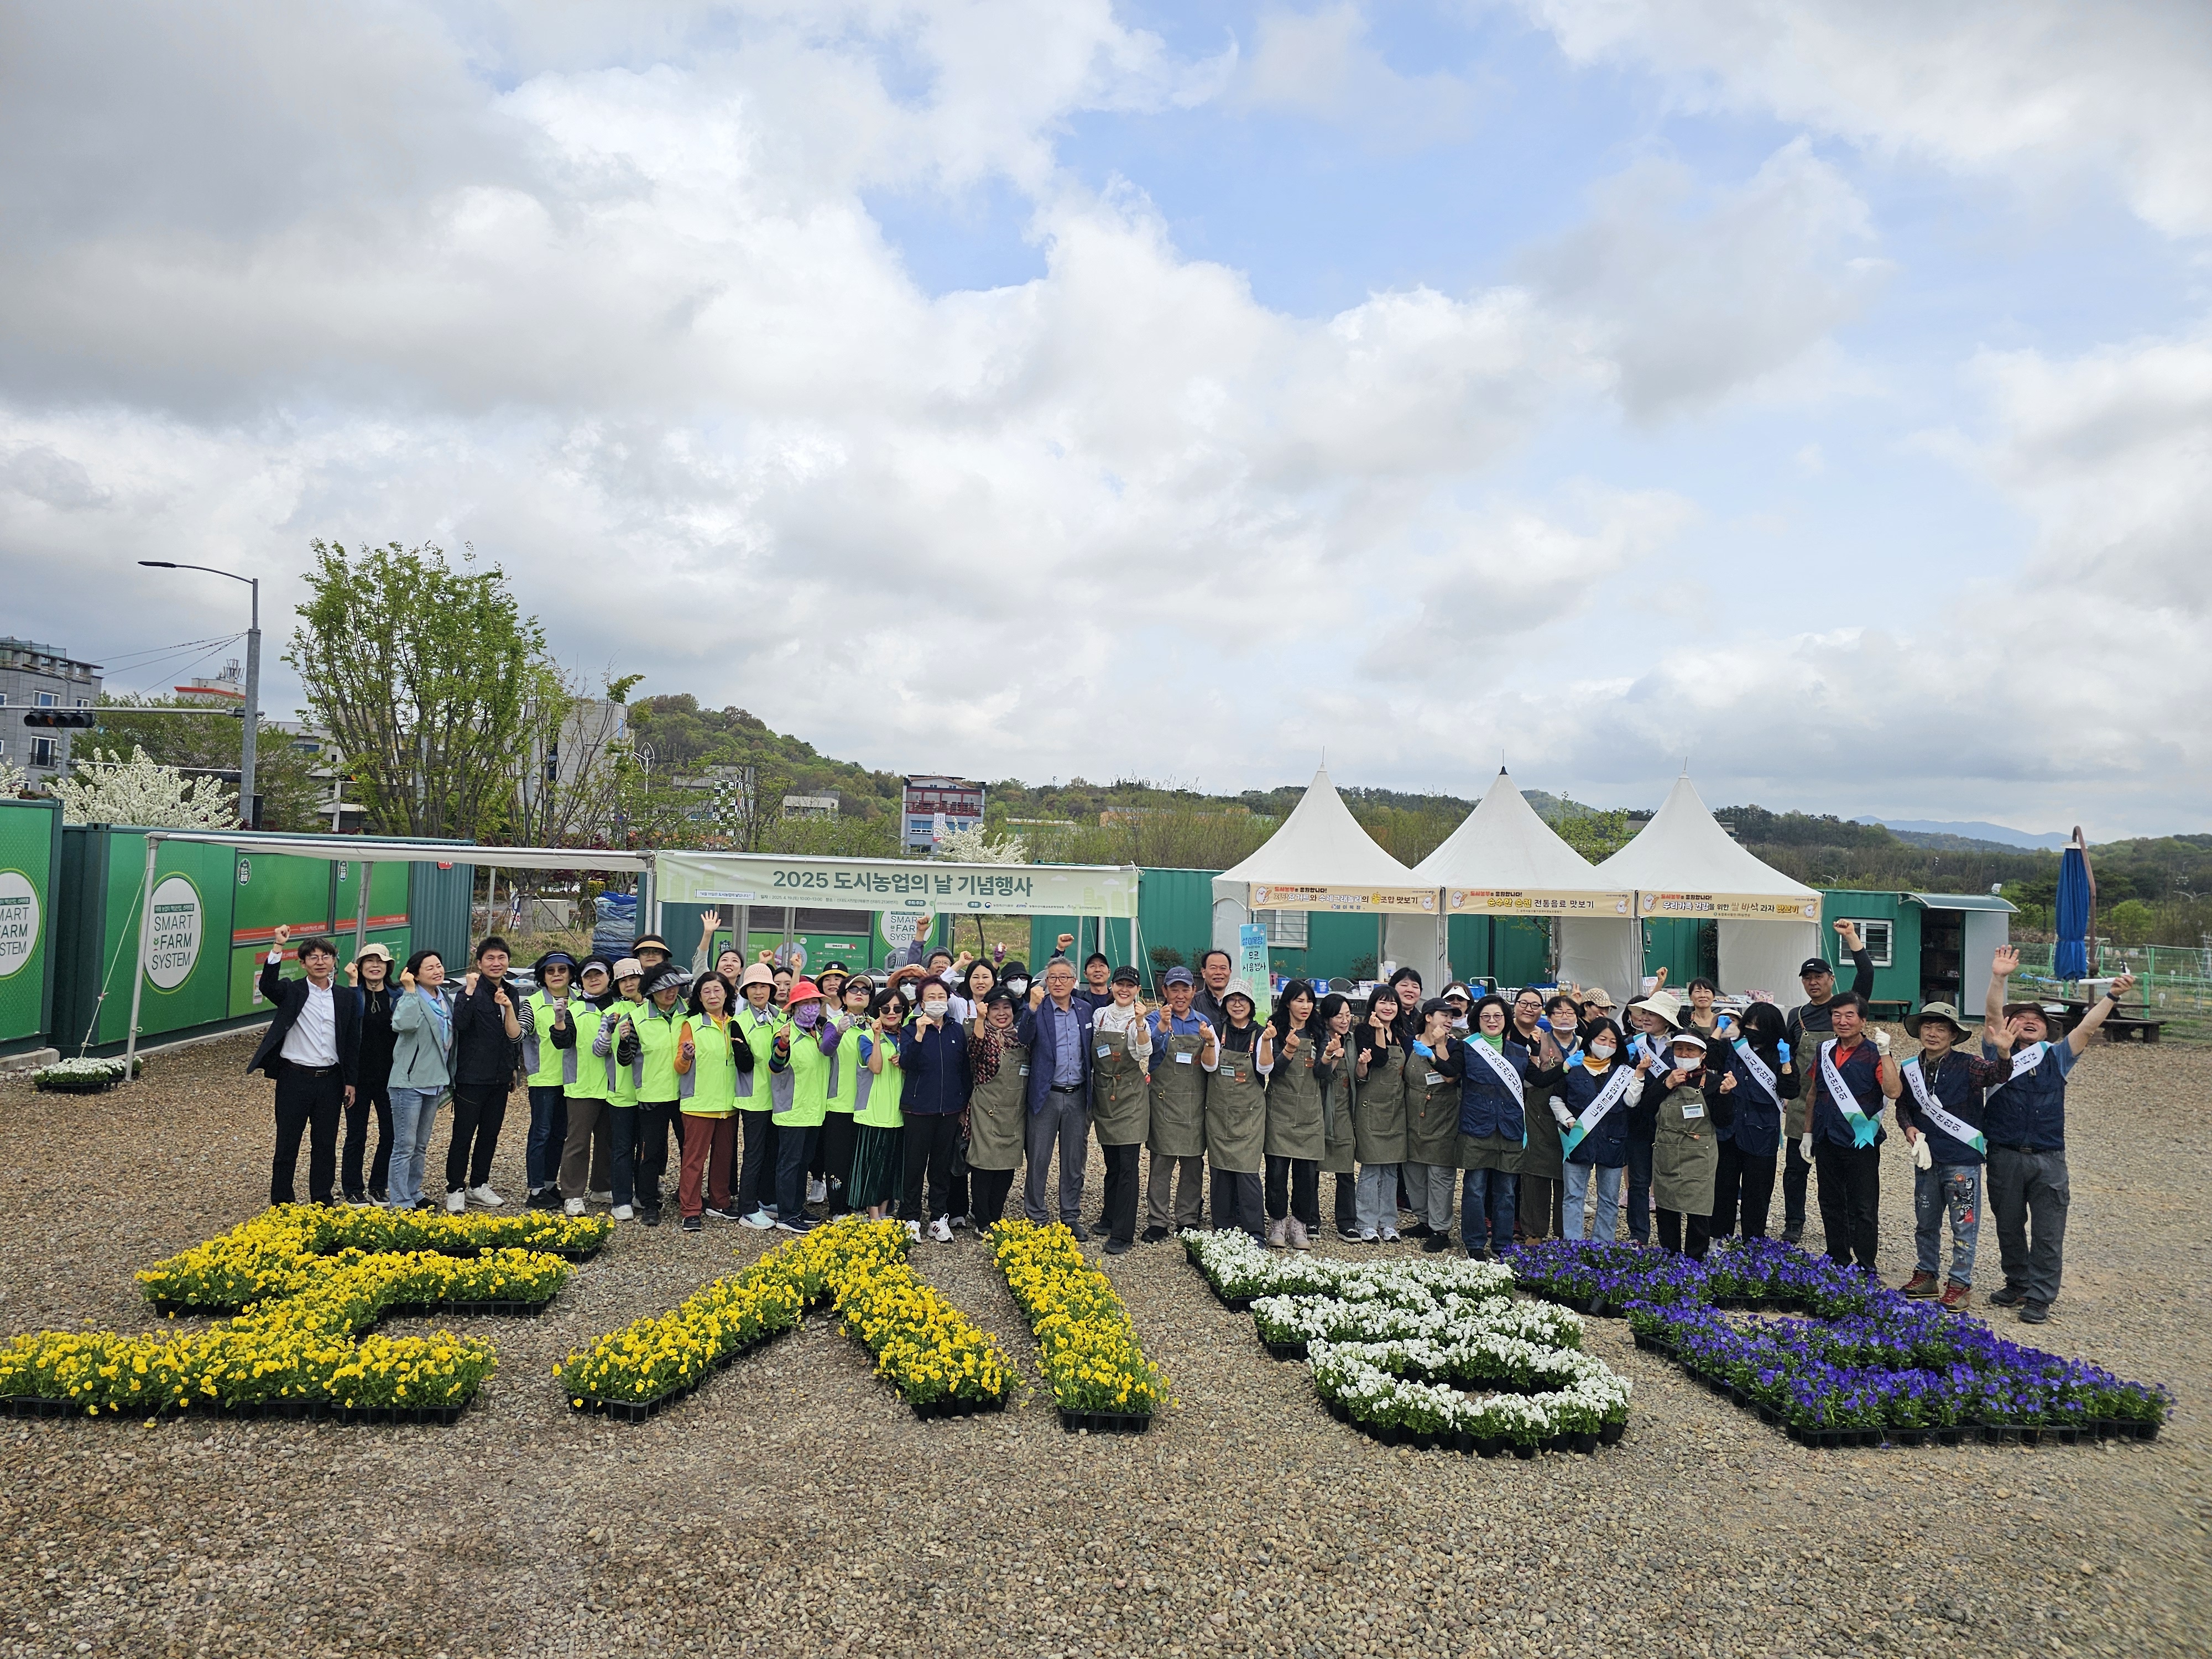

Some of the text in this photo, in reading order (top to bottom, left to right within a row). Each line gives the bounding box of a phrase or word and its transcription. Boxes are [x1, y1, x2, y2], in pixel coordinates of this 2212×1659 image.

[773, 870, 1034, 897] 2025 도시농업의 날 기념행사
[1396, 896, 1418, 904] 맛보기
[1487, 898, 1594, 909] 순수한 순천 전통음료 맛보기
[1663, 901, 1693, 910] 우리가족
[1695, 902, 1715, 911] 건강을
[1776, 904, 1799, 914] 맛보기
[154, 915, 193, 931] SMART
[160, 932, 192, 950] FARM
[1242, 936, 1263, 946] 설이목장
[152, 952, 191, 970] SYSTEM
[1249, 951, 1260, 959] 무료
[1243, 962, 1266, 972] 시음행사
